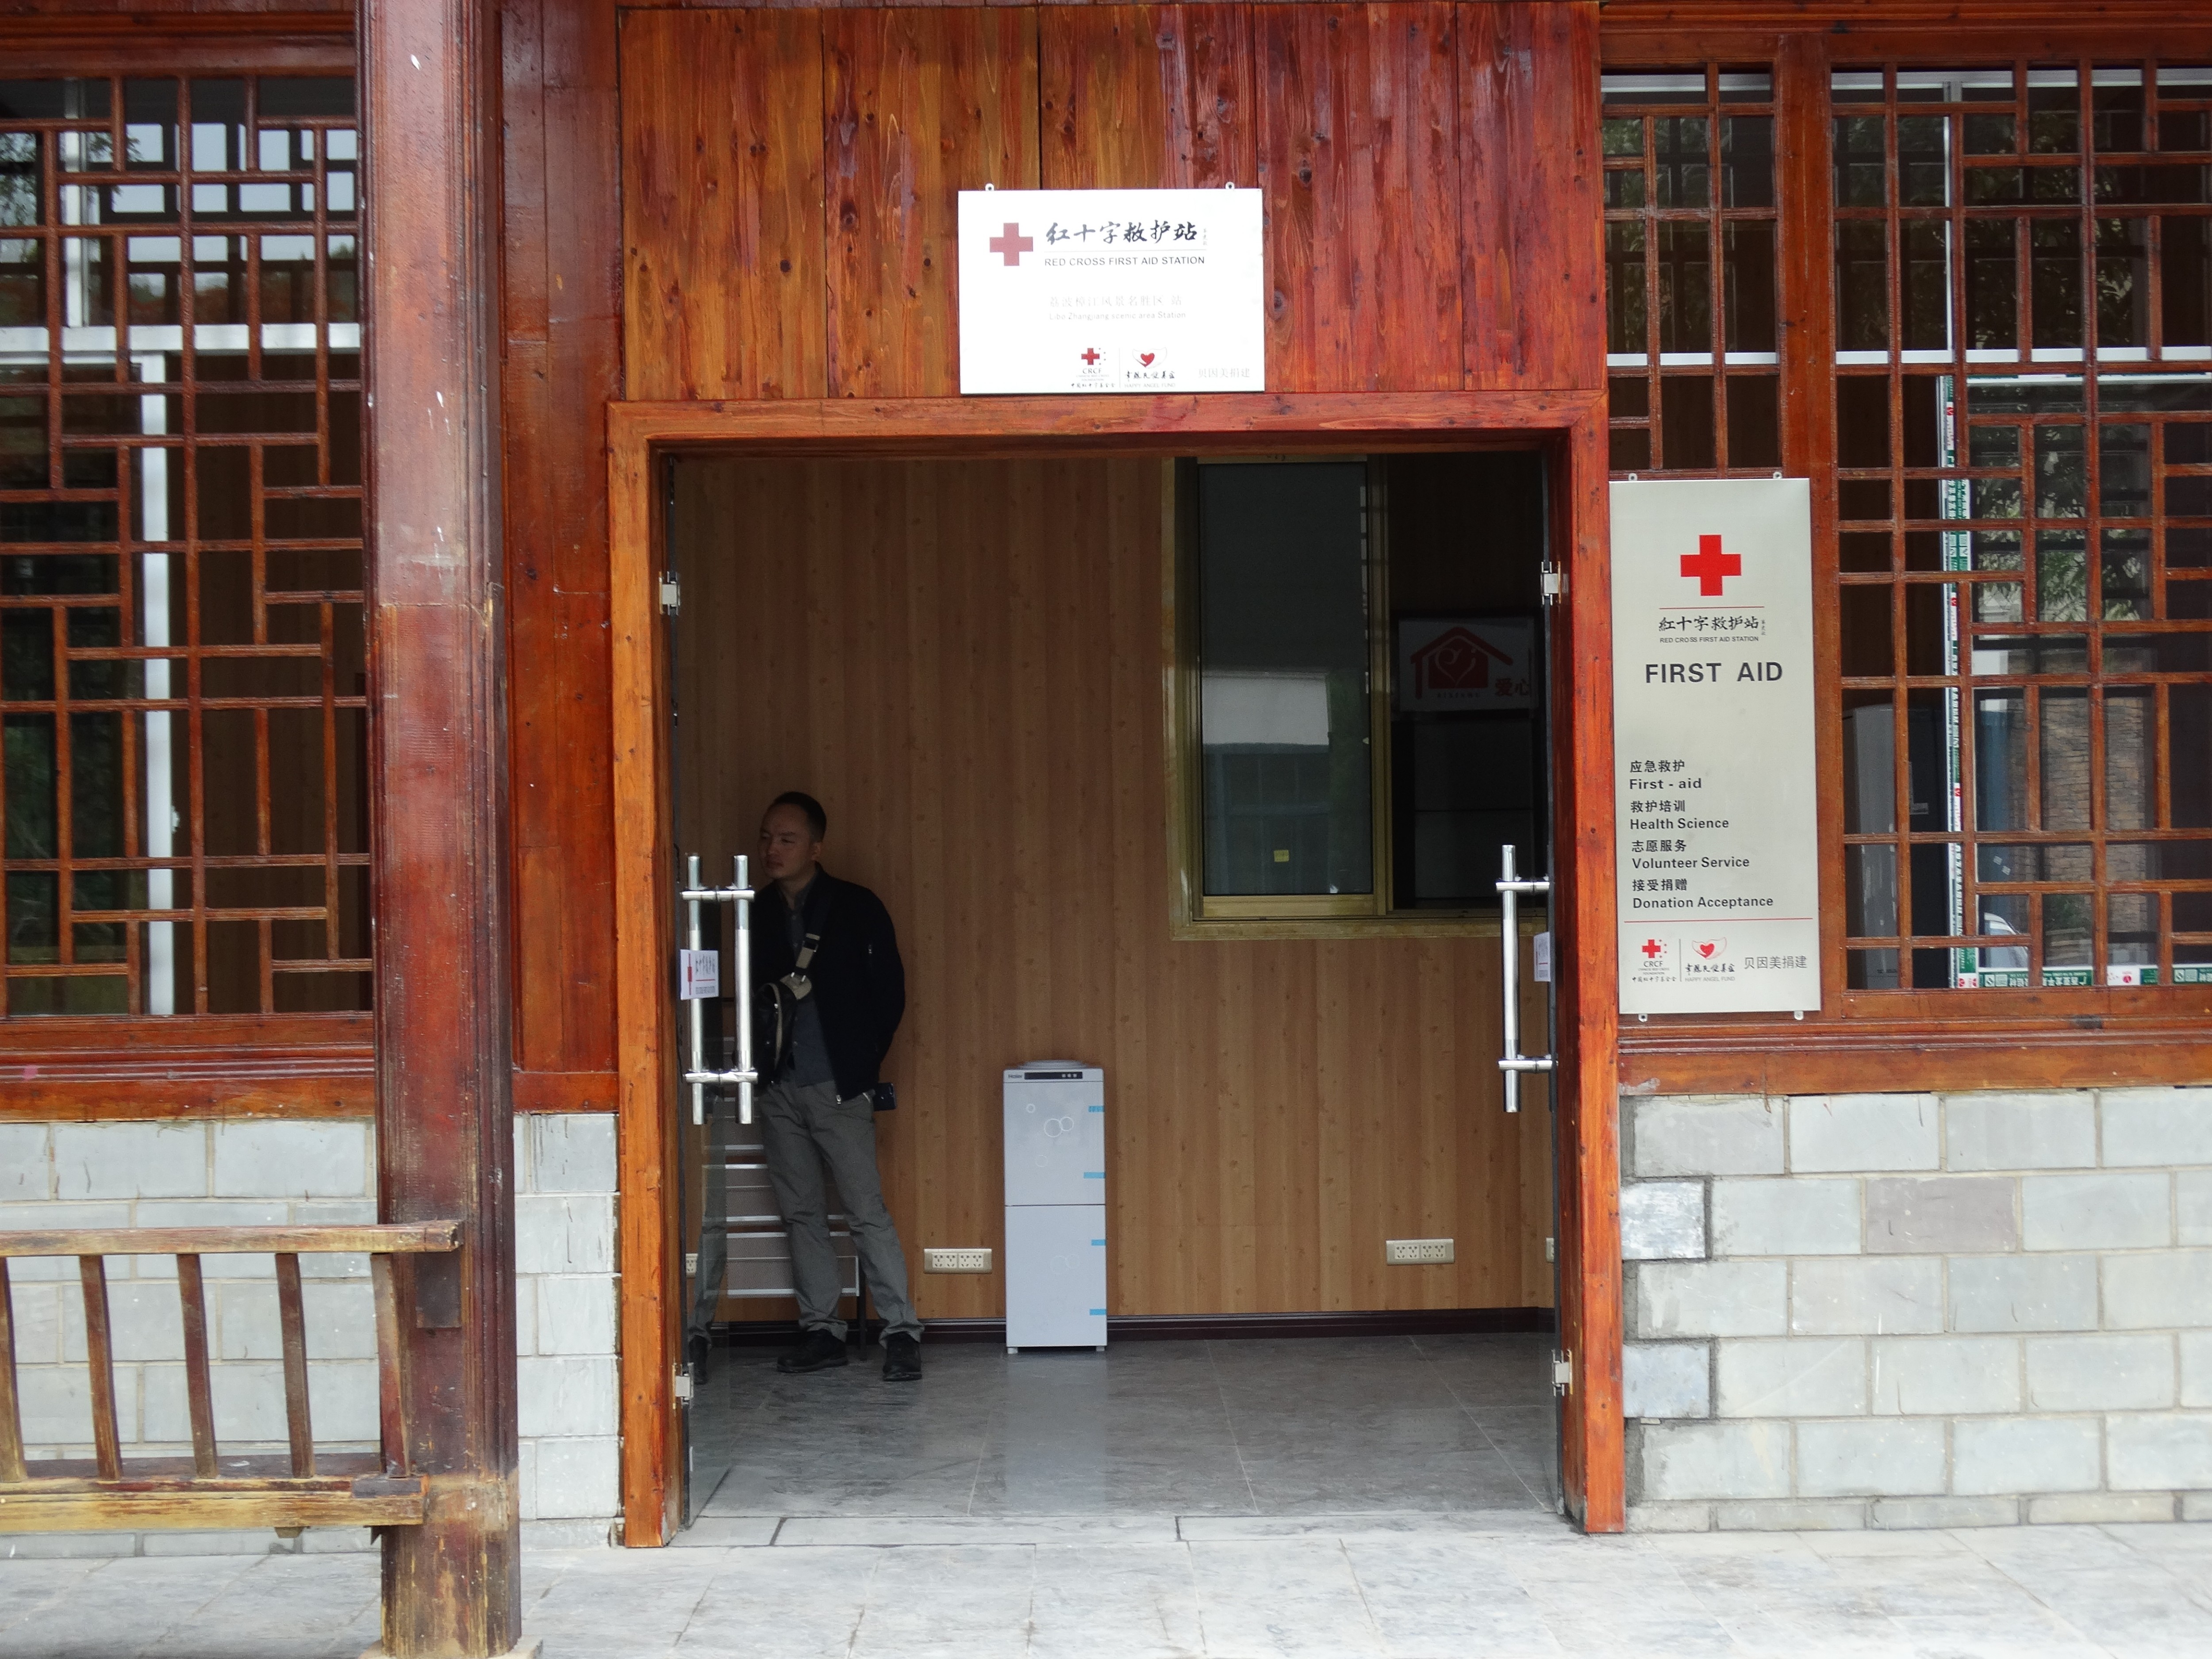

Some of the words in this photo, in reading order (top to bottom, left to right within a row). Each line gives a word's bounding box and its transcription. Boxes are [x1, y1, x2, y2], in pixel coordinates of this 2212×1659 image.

[1069, 257, 1105, 266] CROSS
[1162, 256, 1205, 265] STATION
[1646, 662, 1722, 683] FIRST
[1737, 662, 1783, 682] AID
[1630, 759, 1685, 773] 应急救护
[1630, 779, 1664, 789] First
[1678, 778, 1701, 789] aid
[1631, 800, 1686, 813] 救护培训
[1630, 818, 1674, 830] Health
[1678, 818, 1729, 829] Science
[1632, 839, 1687, 853] 志愿服务
[1632, 858, 1697, 869] Volunteer
[1701, 856, 1750, 868] Service
[1632, 878, 1687, 891] 接受捐赠
[1633, 897, 1693, 908] Donation
[1697, 896, 1774, 909] Acceptance
[1744, 955, 1808, 969] 贝因美捐建
